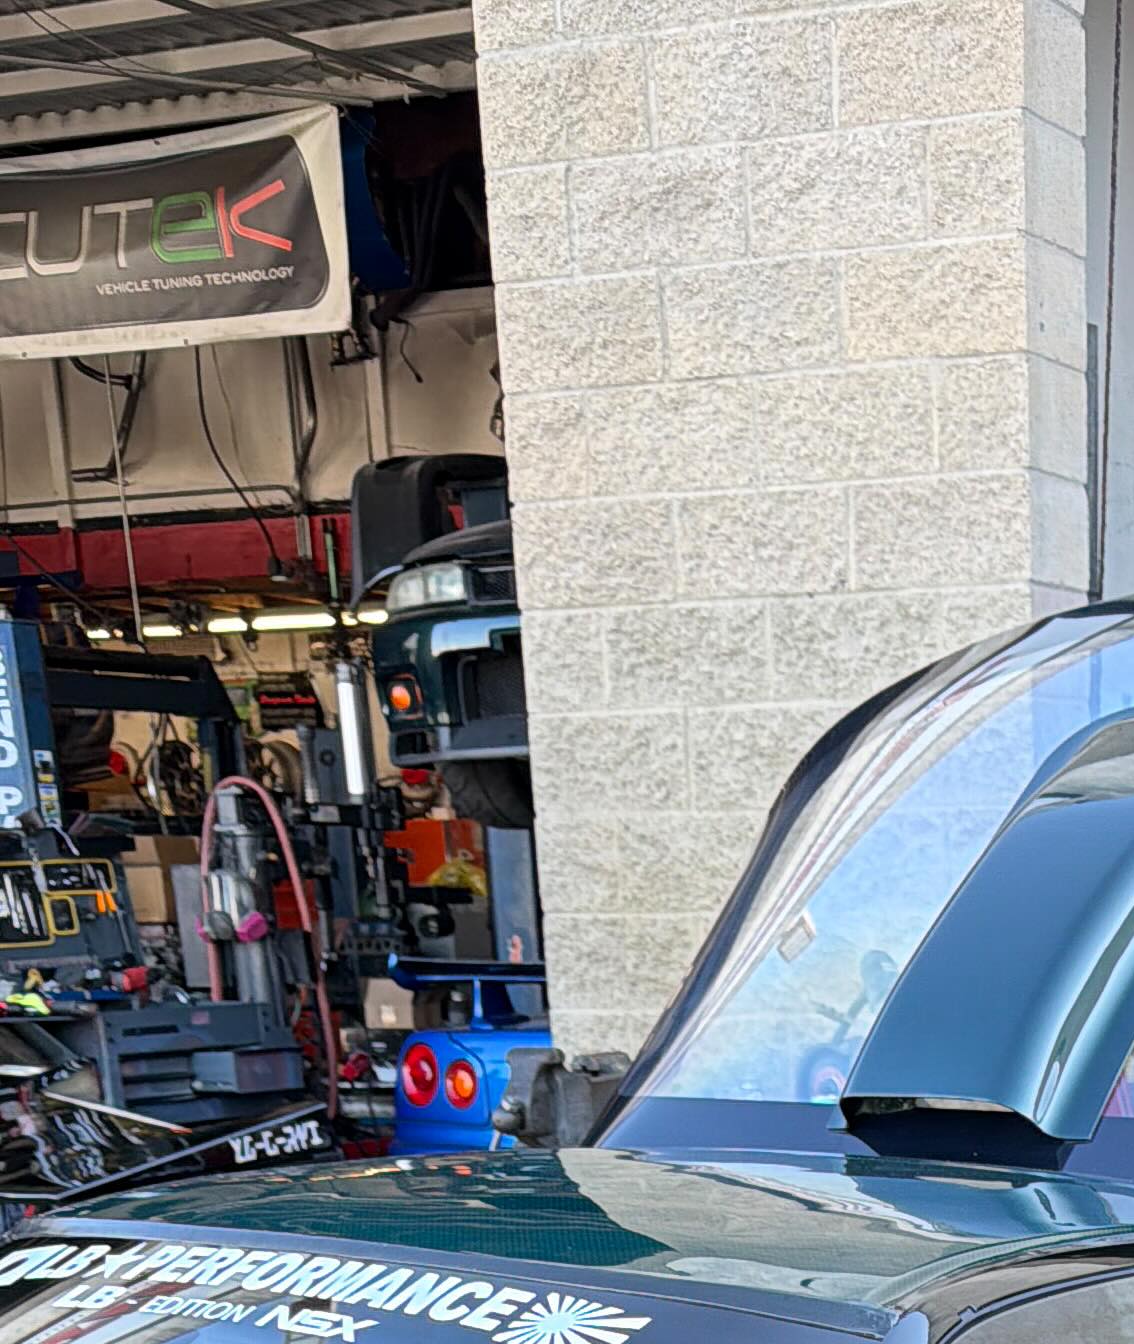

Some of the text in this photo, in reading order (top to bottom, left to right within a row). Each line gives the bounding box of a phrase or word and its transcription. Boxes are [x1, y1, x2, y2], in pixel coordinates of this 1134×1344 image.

[96, 265, 294, 296] VEHICLE TUNING TECHNOLOGY
[255, 1304, 381, 1343] NSX
